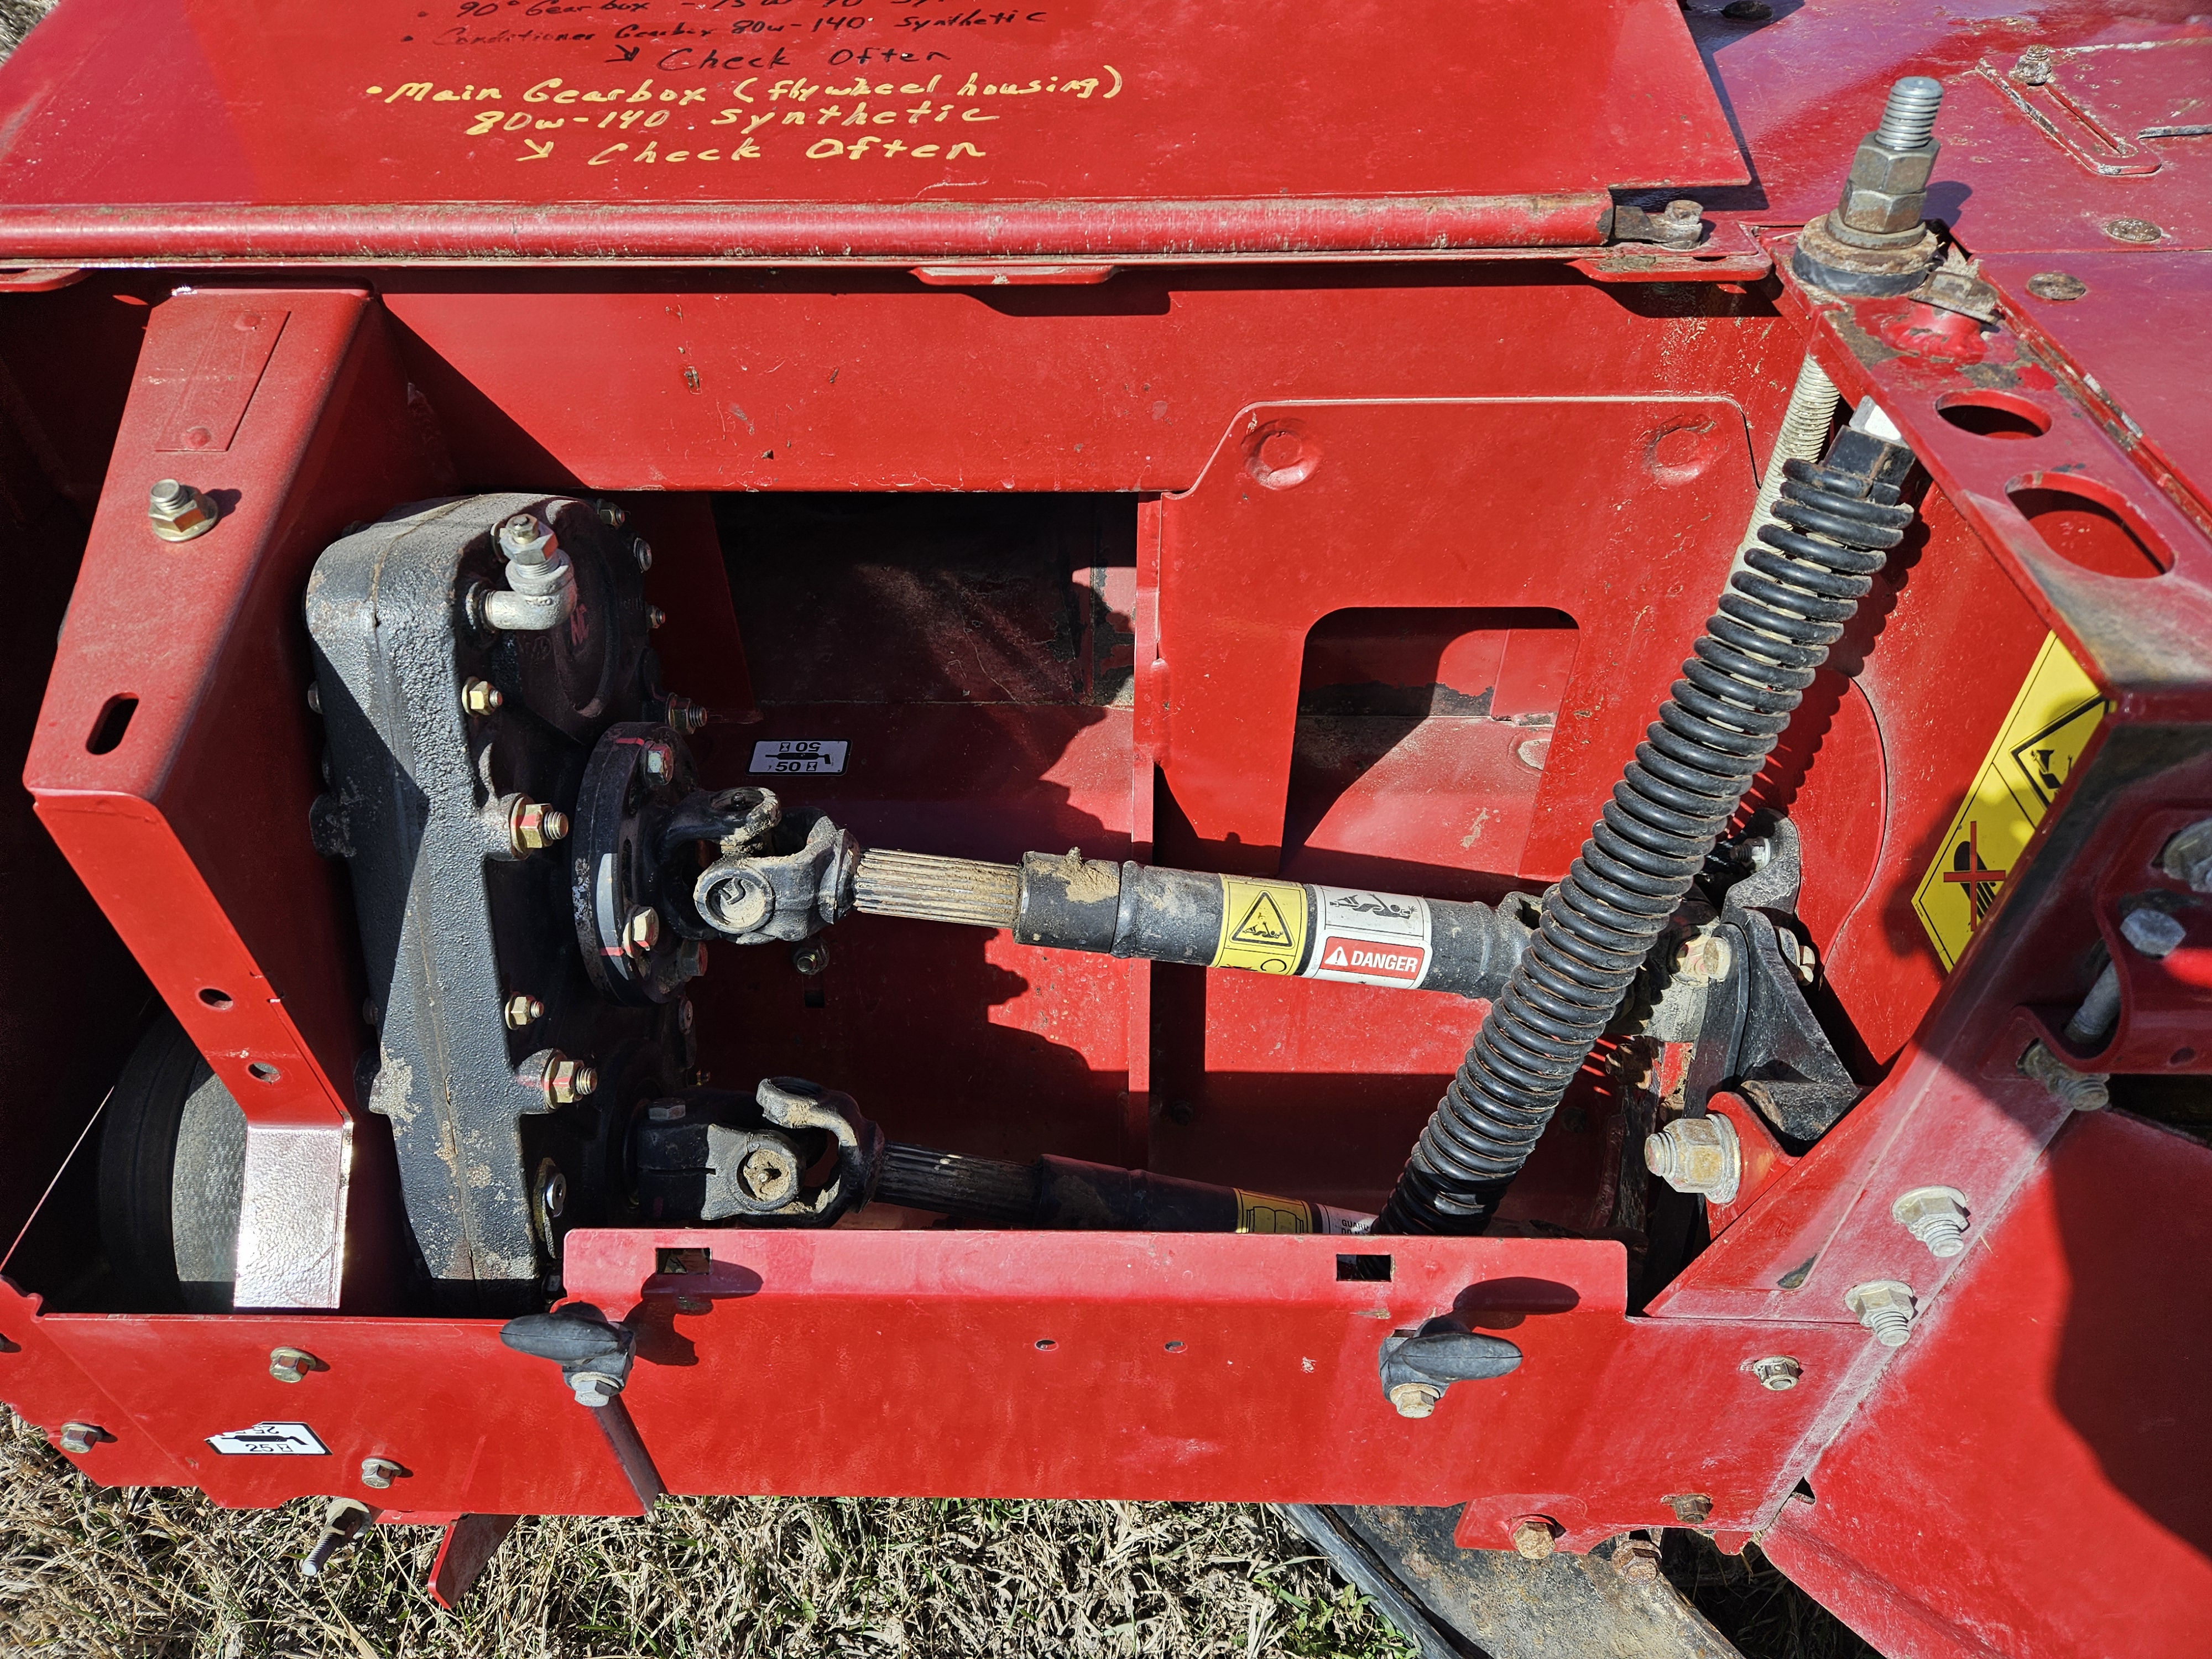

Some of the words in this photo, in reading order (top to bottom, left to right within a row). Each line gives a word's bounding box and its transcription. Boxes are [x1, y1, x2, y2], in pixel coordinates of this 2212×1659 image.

[656, 47, 791, 71] Check
[828, 47, 952, 66] Often
[384, 81, 502, 103] Main
[587, 137, 761, 165] Check
[805, 137, 987, 160] Often
[795, 742, 821, 752] 50
[775, 761, 801, 771] 50
[1350, 950, 1418, 973] DANGER
[1342, 1219, 1369, 1231] GUARD
[245, 1443, 274, 1452] 25
